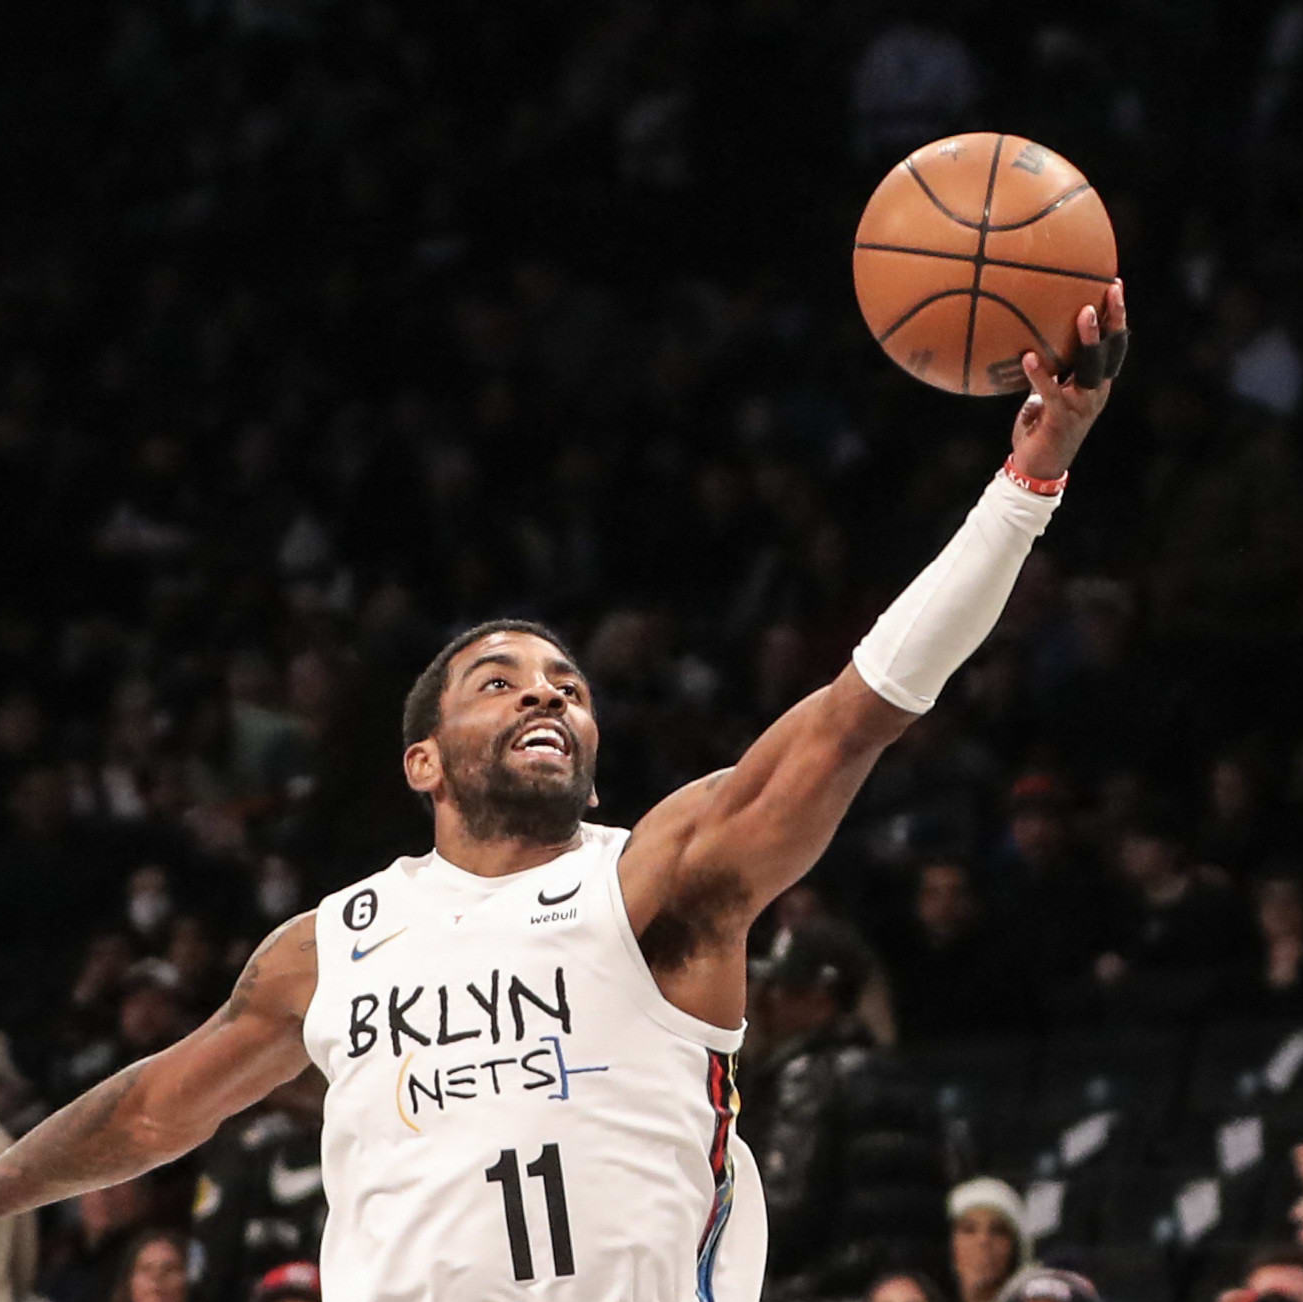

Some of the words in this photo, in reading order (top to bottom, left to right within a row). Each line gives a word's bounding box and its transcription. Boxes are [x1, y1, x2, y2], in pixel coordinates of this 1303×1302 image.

[349, 892, 375, 930] 6
[347, 967, 571, 1058] BKLYN
[485, 1143, 575, 1281] 11
